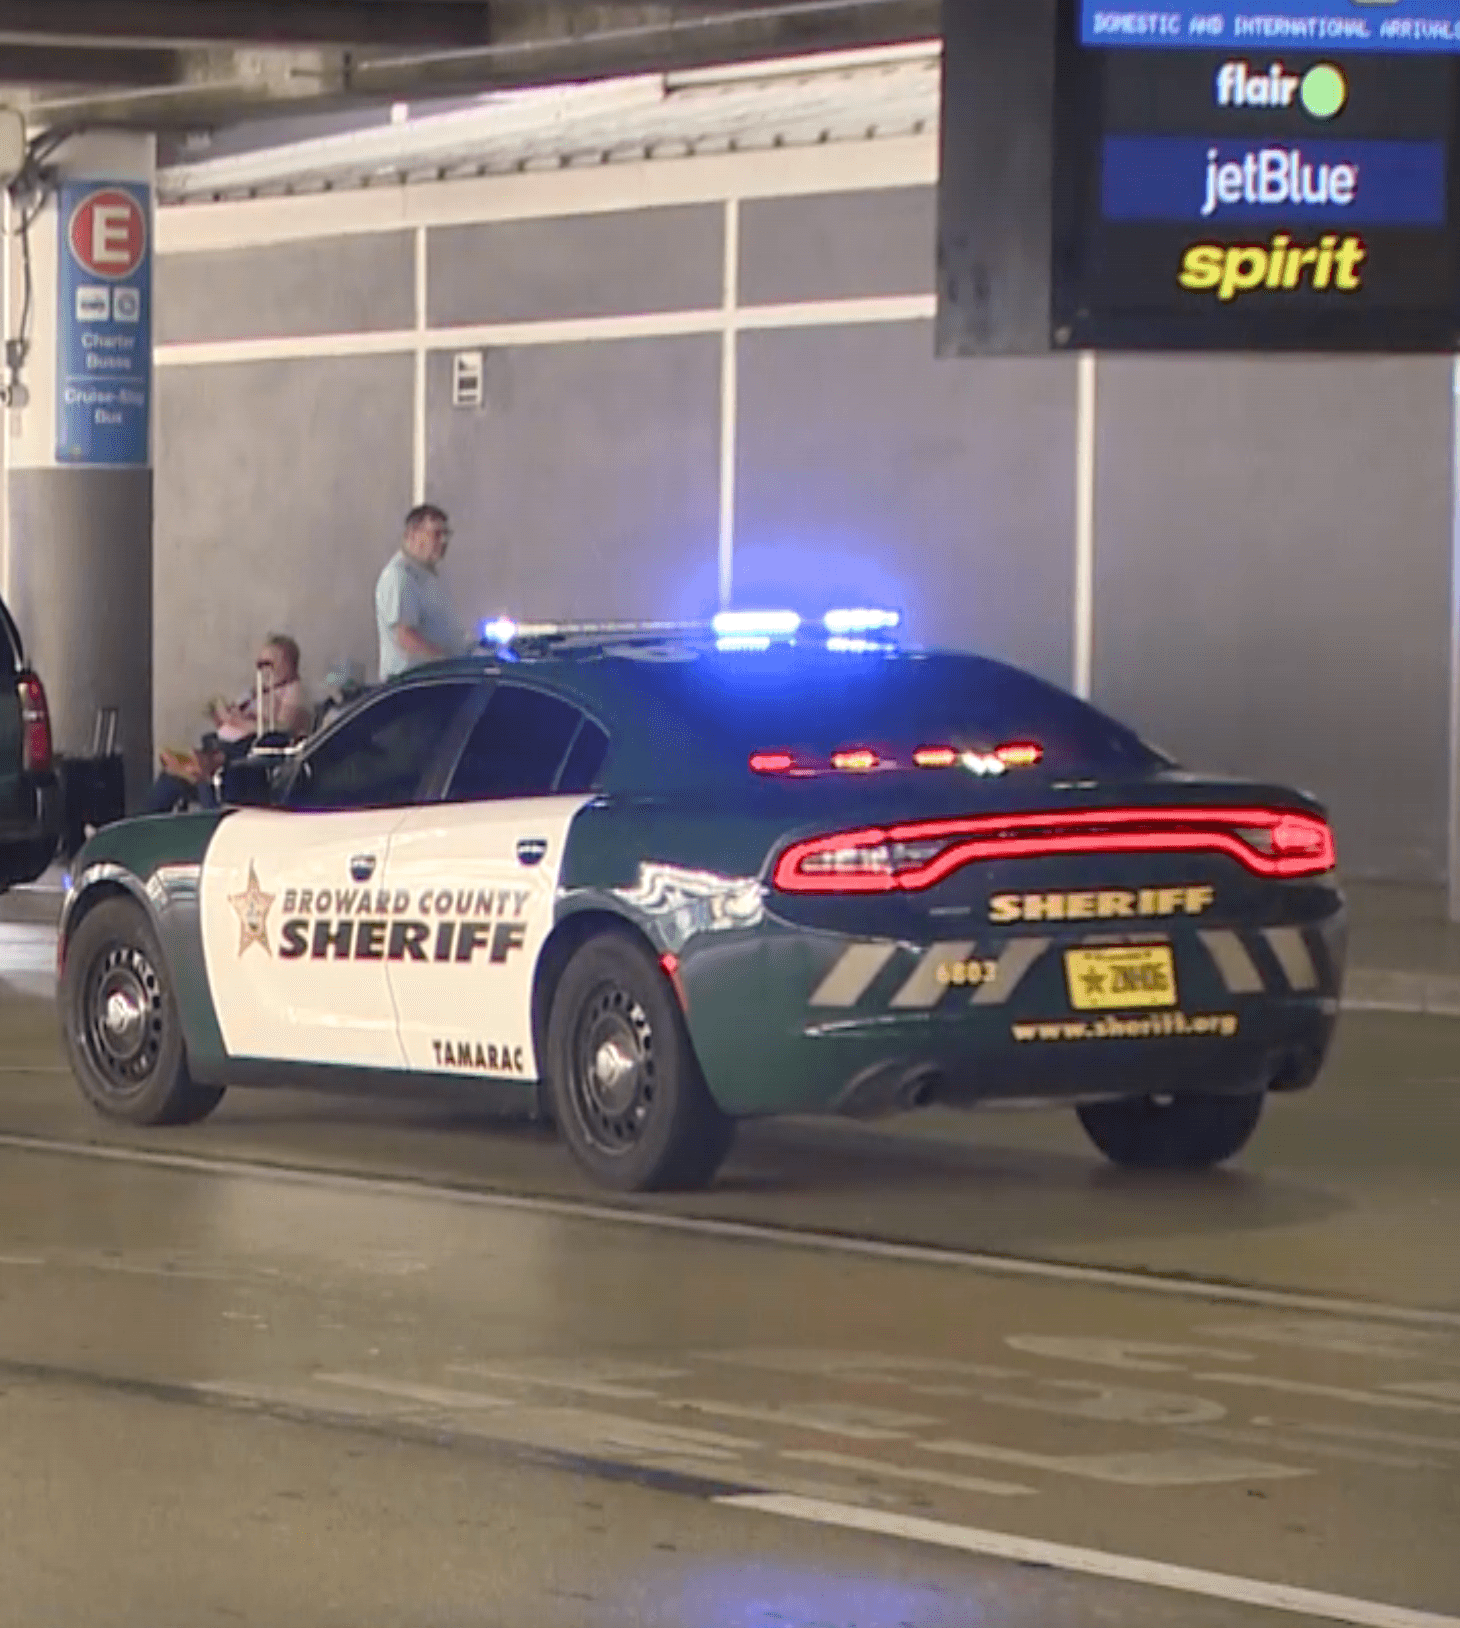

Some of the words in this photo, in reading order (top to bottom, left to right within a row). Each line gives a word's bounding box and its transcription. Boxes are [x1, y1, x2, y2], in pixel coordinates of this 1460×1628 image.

[1217, 63, 1298, 106] flair
[1201, 149, 1356, 216] jetBlue
[93, 205, 131, 263] E
[1178, 236, 1364, 300] spirit
[282, 888, 409, 914] BROWARD
[418, 888, 529, 915] COUNTY
[989, 887, 1214, 922] SHERIFF
[279, 919, 527, 963] SHERIFF
[1012, 1012, 1237, 1043] www.sheriff.org
[433, 1040, 523, 1072] TAMARAC
